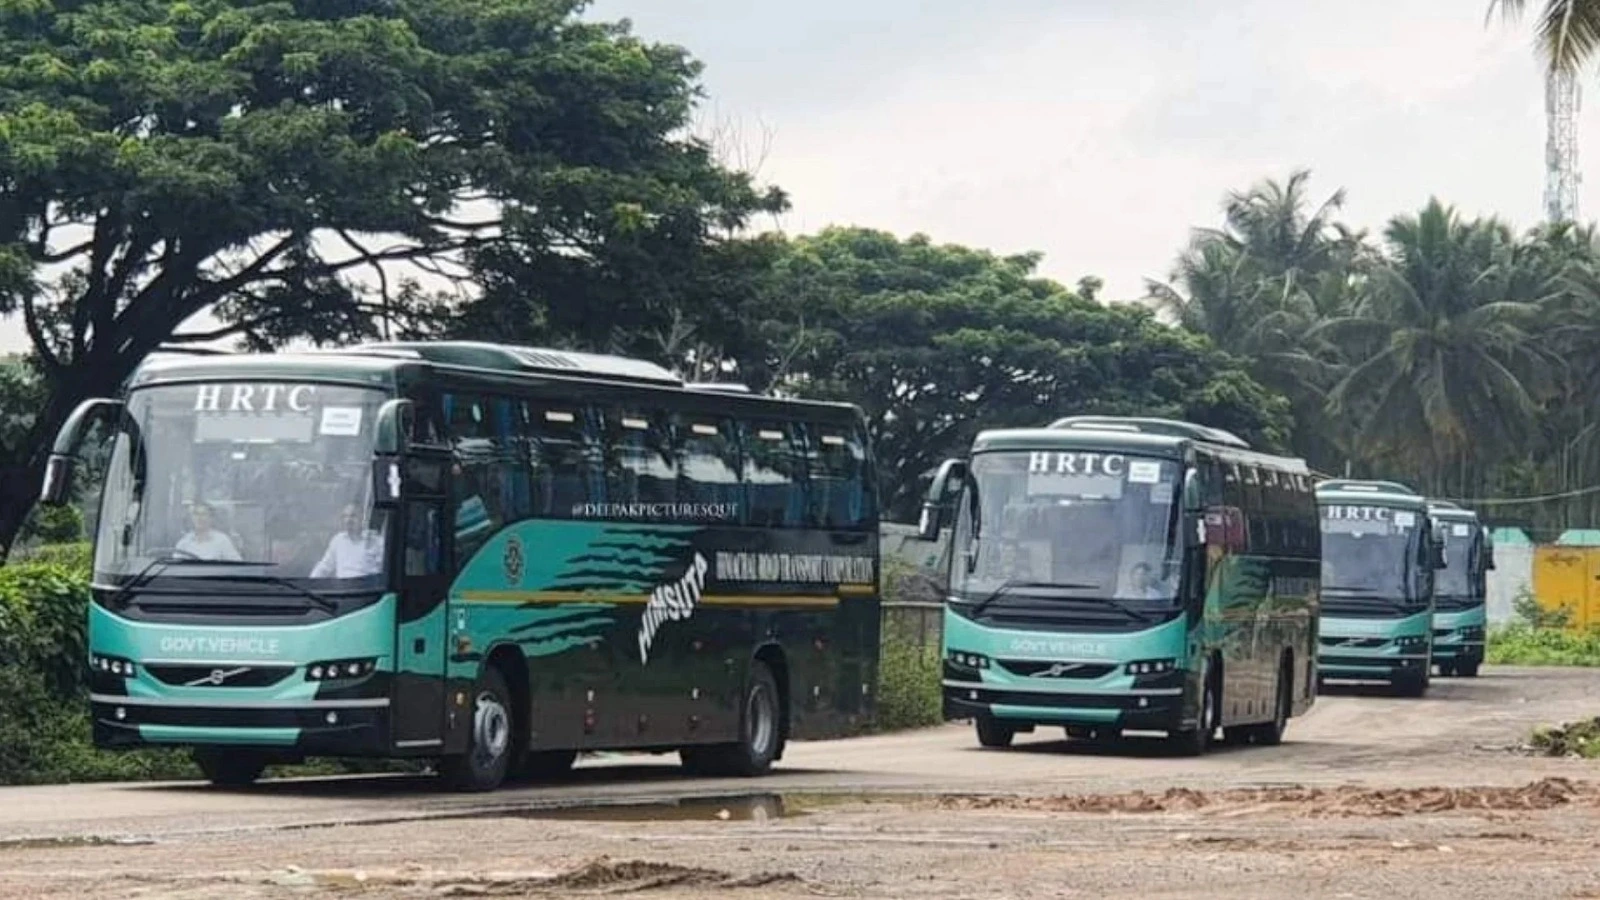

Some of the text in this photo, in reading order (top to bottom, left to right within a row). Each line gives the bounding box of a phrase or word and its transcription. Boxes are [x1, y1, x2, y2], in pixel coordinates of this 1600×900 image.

[194, 384, 315, 412] HRTC
[1028, 452, 1125, 475] HRTC
[1327, 505, 1390, 520] HRTC
